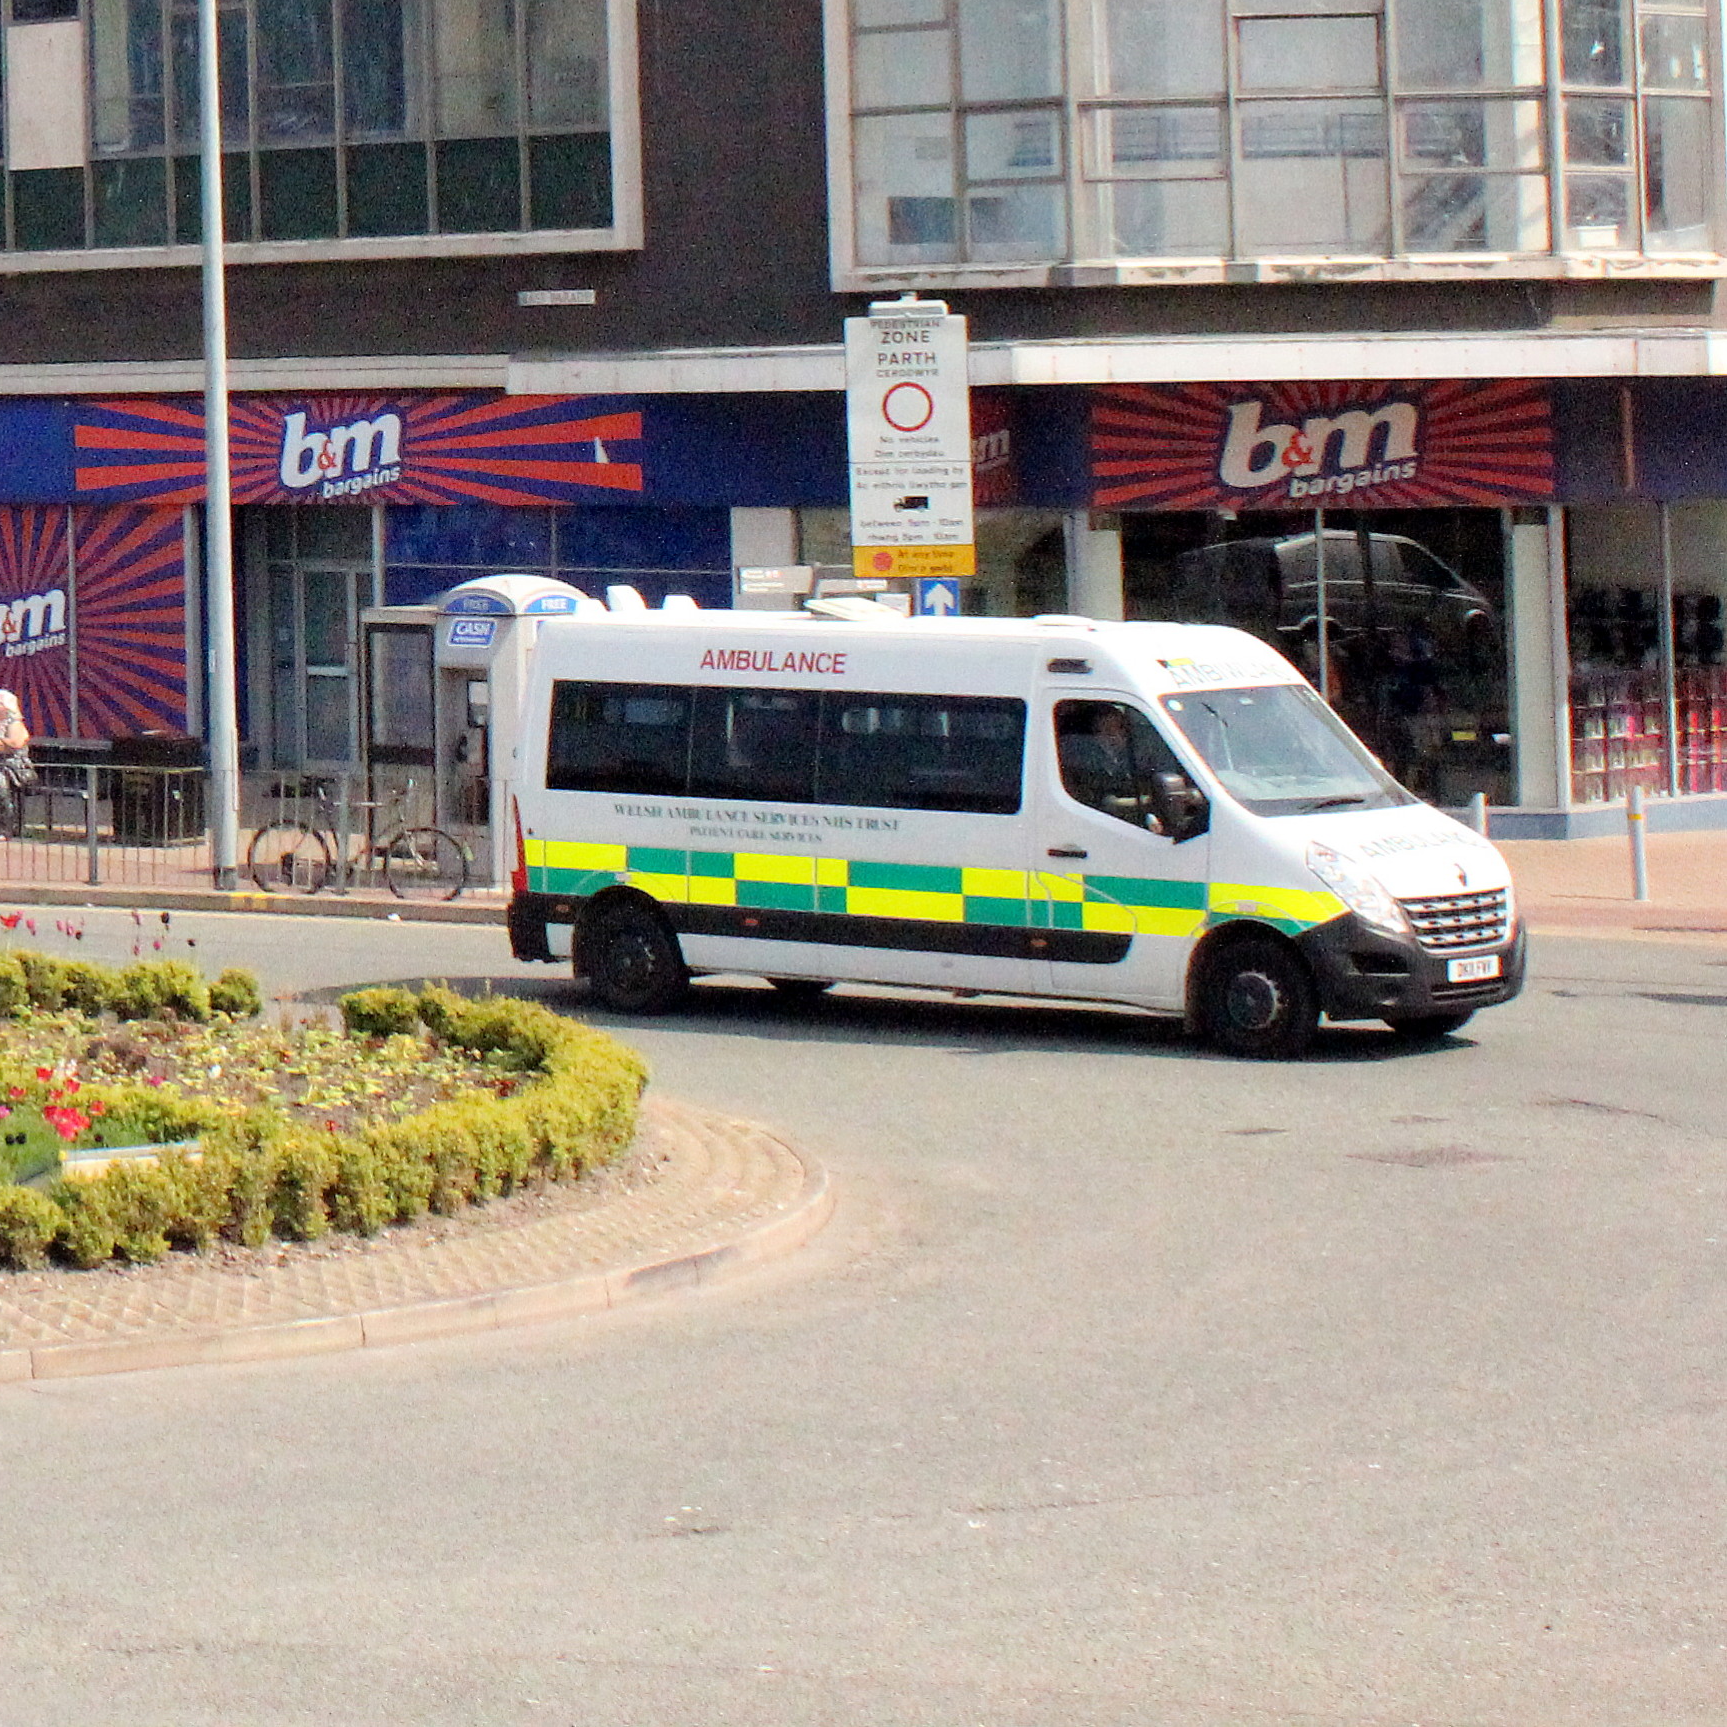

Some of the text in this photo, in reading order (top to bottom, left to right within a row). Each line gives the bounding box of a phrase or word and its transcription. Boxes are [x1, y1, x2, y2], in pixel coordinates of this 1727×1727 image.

[881, 330, 930, 343] ZONE
[878, 352, 936, 365] PARTH
[323, 467, 401, 498] bargains
[1290, 462, 1417, 497] bargains
[700, 649, 848, 674] AMBULANCE
[614, 804, 900, 832] WELSH AMBULANCE SERVICES NHS TRUST
